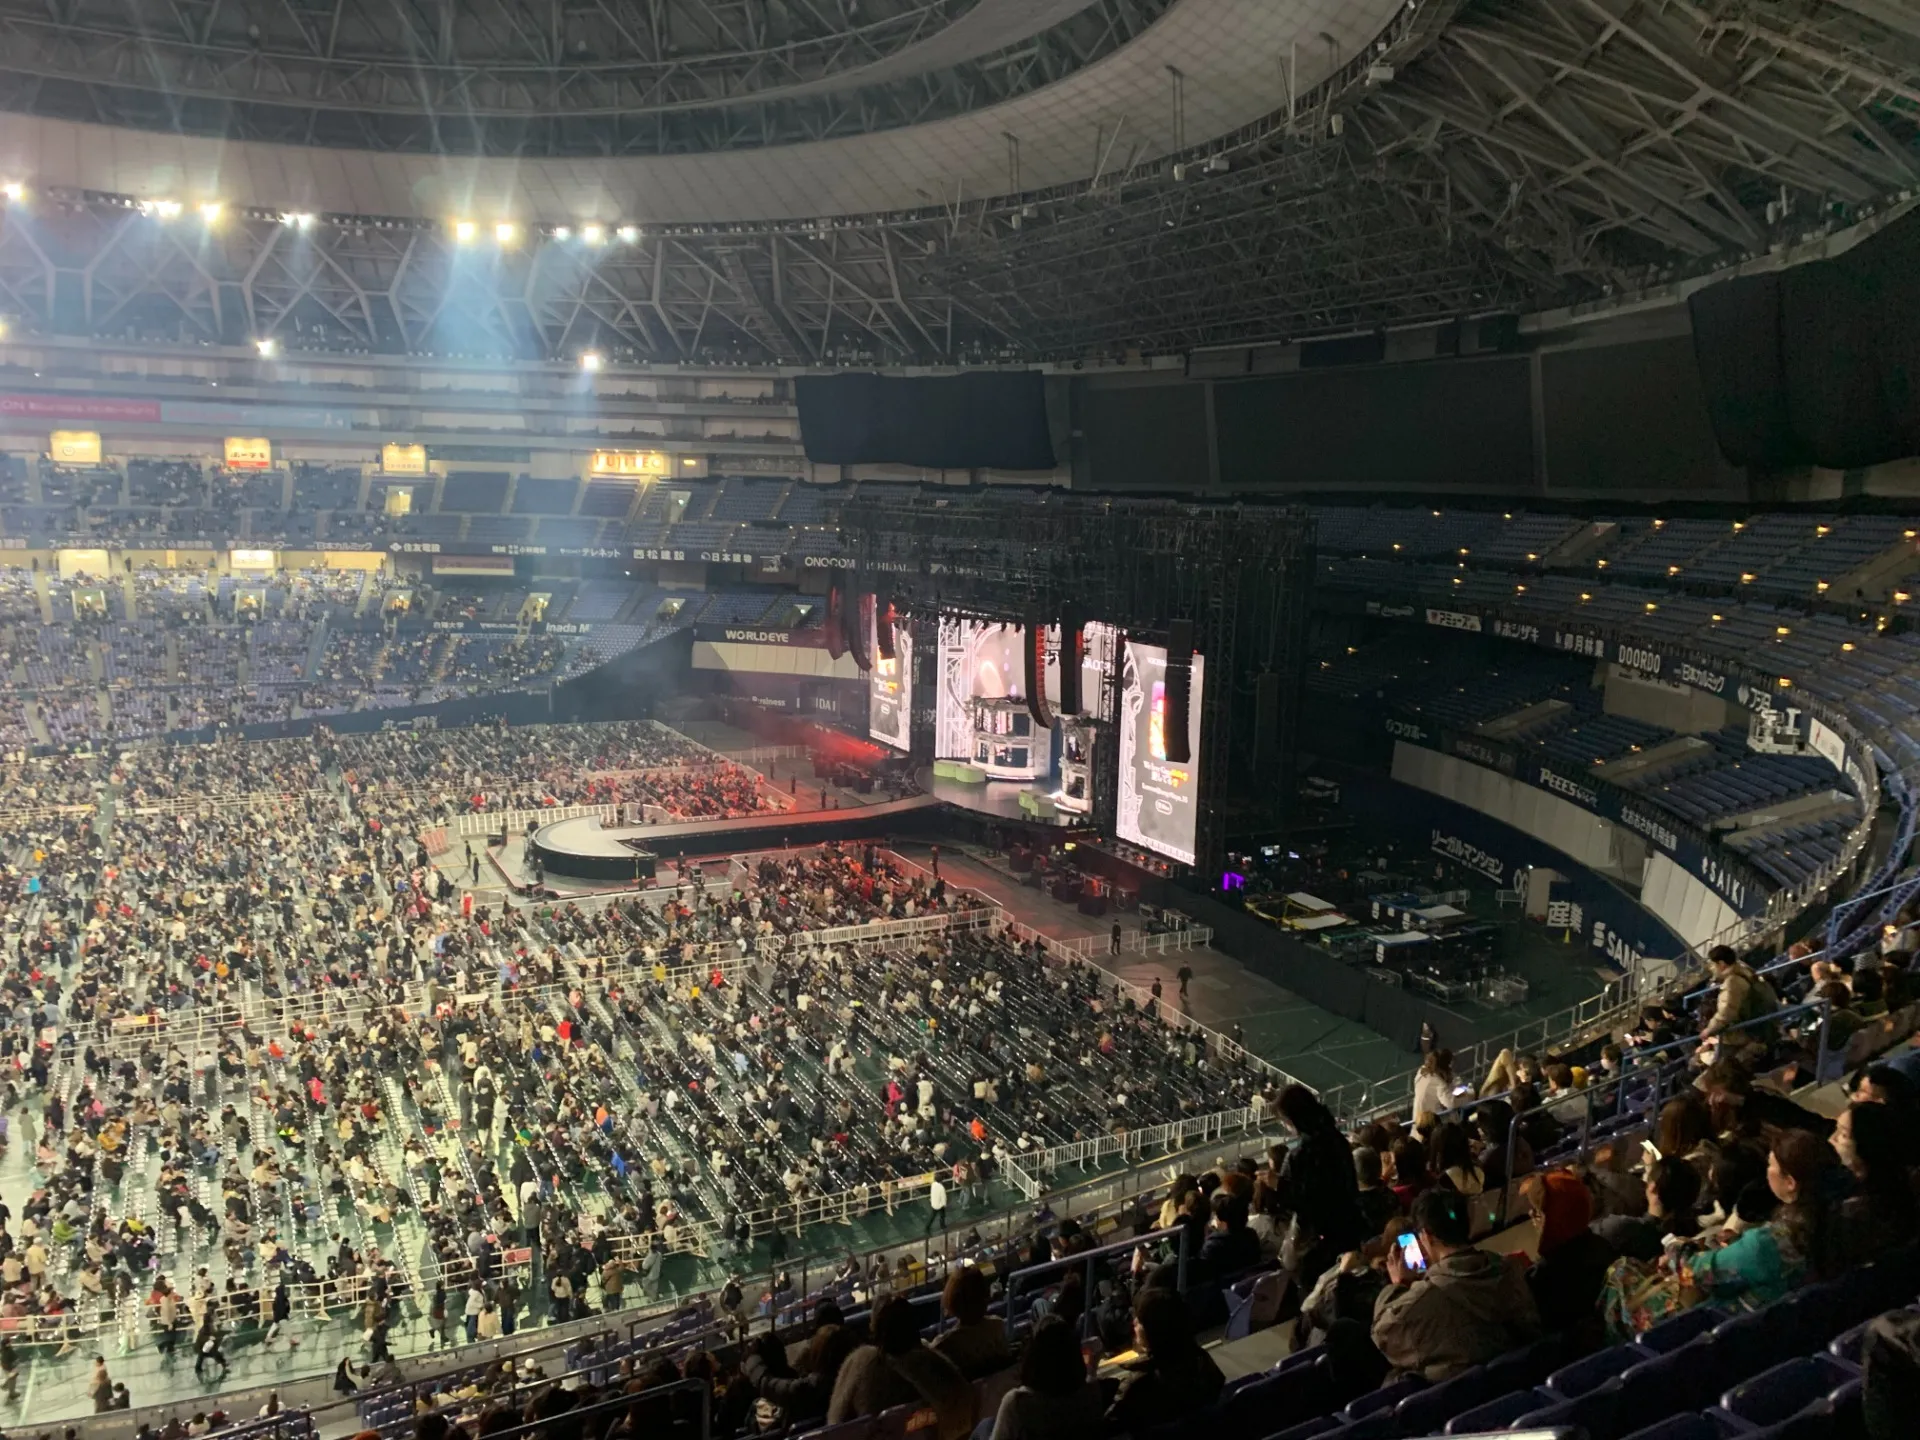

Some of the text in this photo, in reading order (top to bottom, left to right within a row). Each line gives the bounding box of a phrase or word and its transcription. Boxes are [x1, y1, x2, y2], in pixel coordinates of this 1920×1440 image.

[1431, 828, 1504, 878] リーガルマンション
